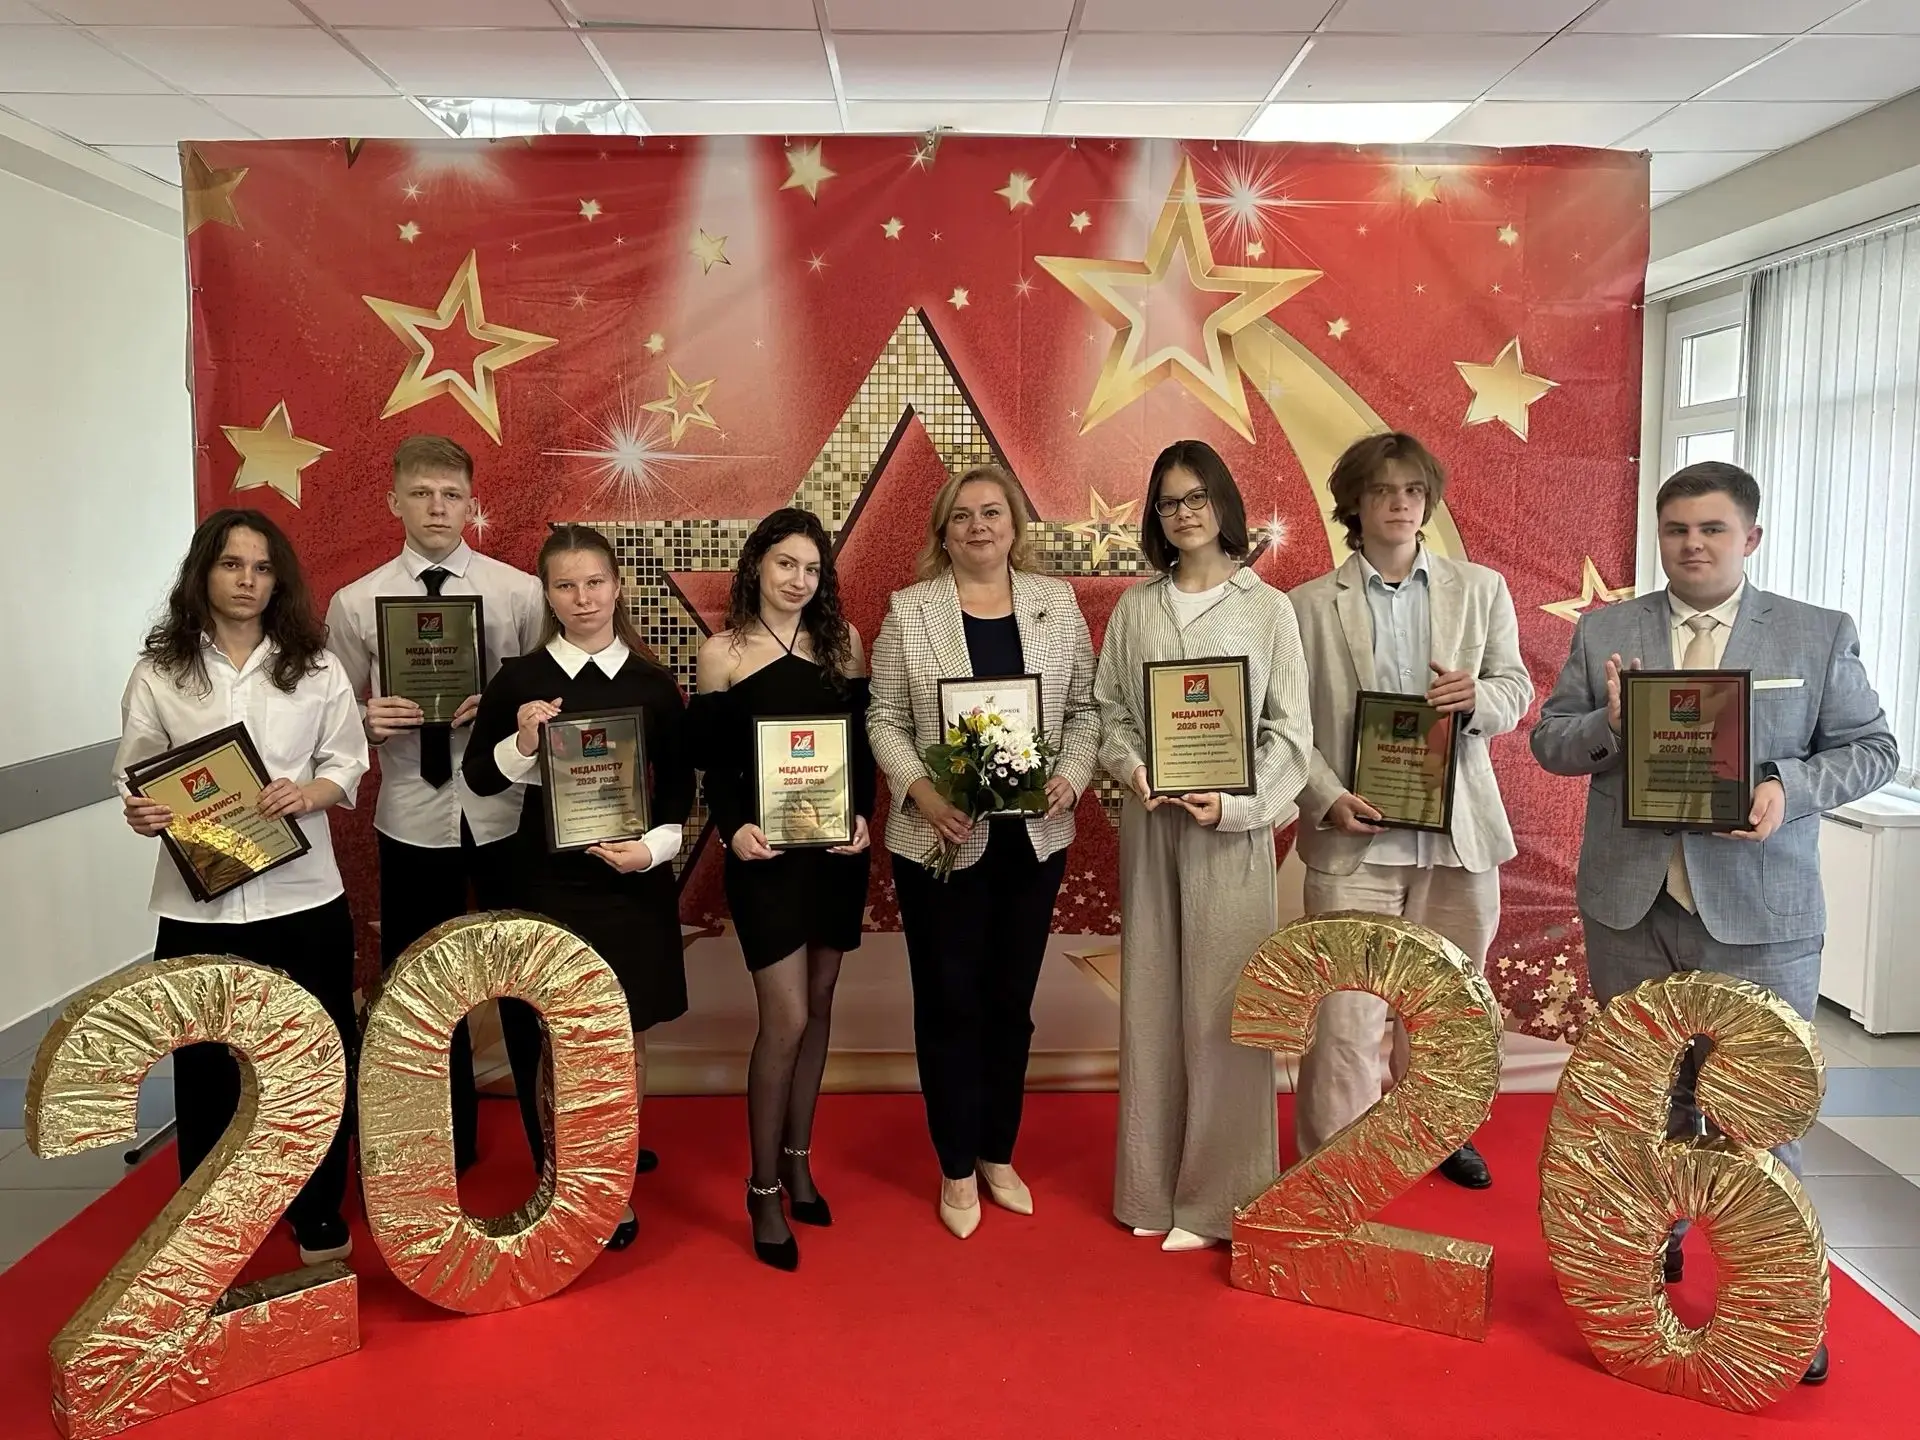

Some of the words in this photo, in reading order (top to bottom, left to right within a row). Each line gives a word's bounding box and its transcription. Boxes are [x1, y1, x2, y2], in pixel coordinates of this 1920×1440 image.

[1171, 708, 1225, 720] МЕДАЛИСТУ
[1176, 722, 1198, 731] 2026
[1200, 722, 1221, 731] года
[1652, 730, 1719, 741] МЕДАЛИСТУ
[1377, 743, 1431, 756] МЕДАЛИСТУ
[1659, 744, 1684, 754] 2026
[1687, 745, 1712, 756] года
[570, 762, 623, 775] МЕДАЛИСТУ
[778, 765, 829, 774] МЕДАЛИСТУ
[576, 777, 597, 786] 2026
[599, 775, 620, 786] года
[783, 777, 803, 786] 2026
[805, 777, 825, 786] года
[187, 791, 242, 824] МЕДАЛИСТУ
[223, 805, 245, 821] года
